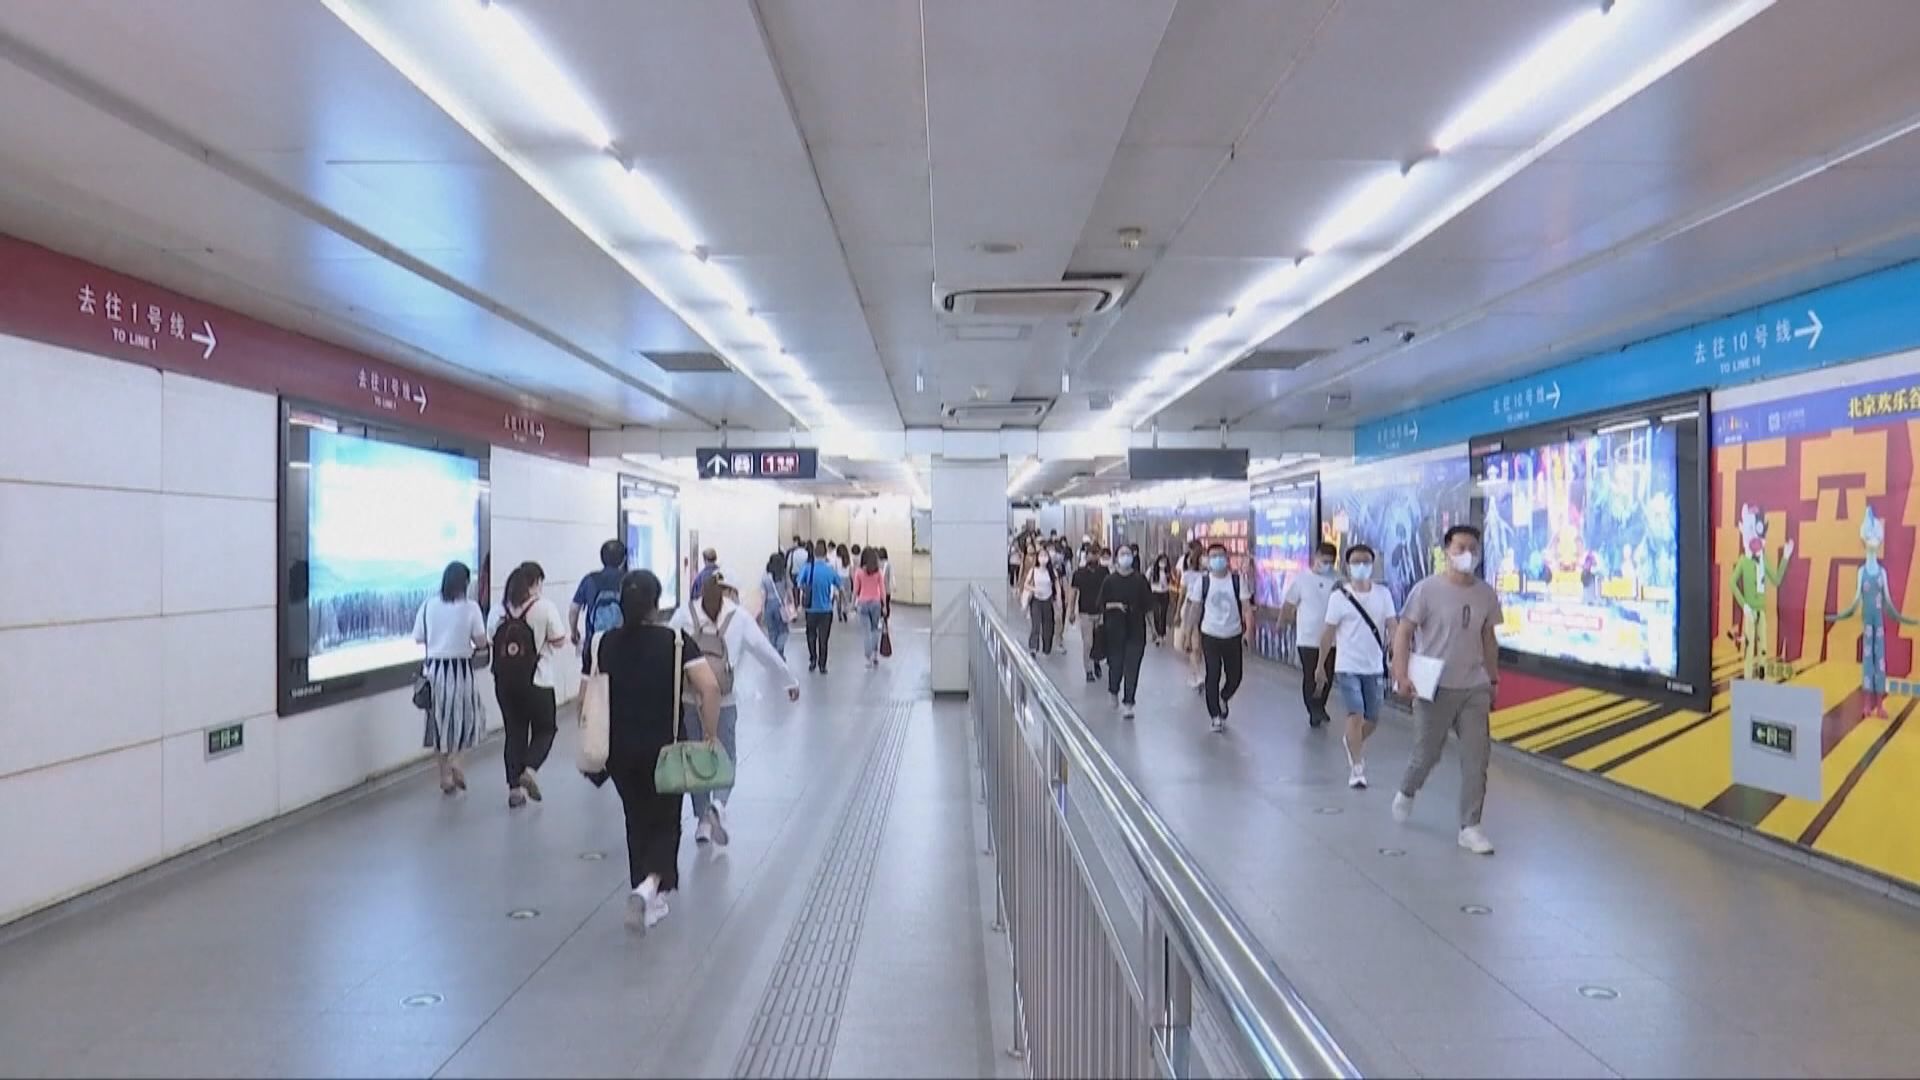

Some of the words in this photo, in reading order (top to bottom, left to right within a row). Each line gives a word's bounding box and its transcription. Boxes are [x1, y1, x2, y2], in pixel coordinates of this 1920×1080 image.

[78, 284, 186, 340] 去往1号线
[111, 327, 126, 344] TO
[129, 332, 150, 349] LINE
[151, 338, 158, 351] 1
[1694, 318, 1792, 364] 去往10号线
[1848, 385, 1920, 419] 北京欢乐谷
